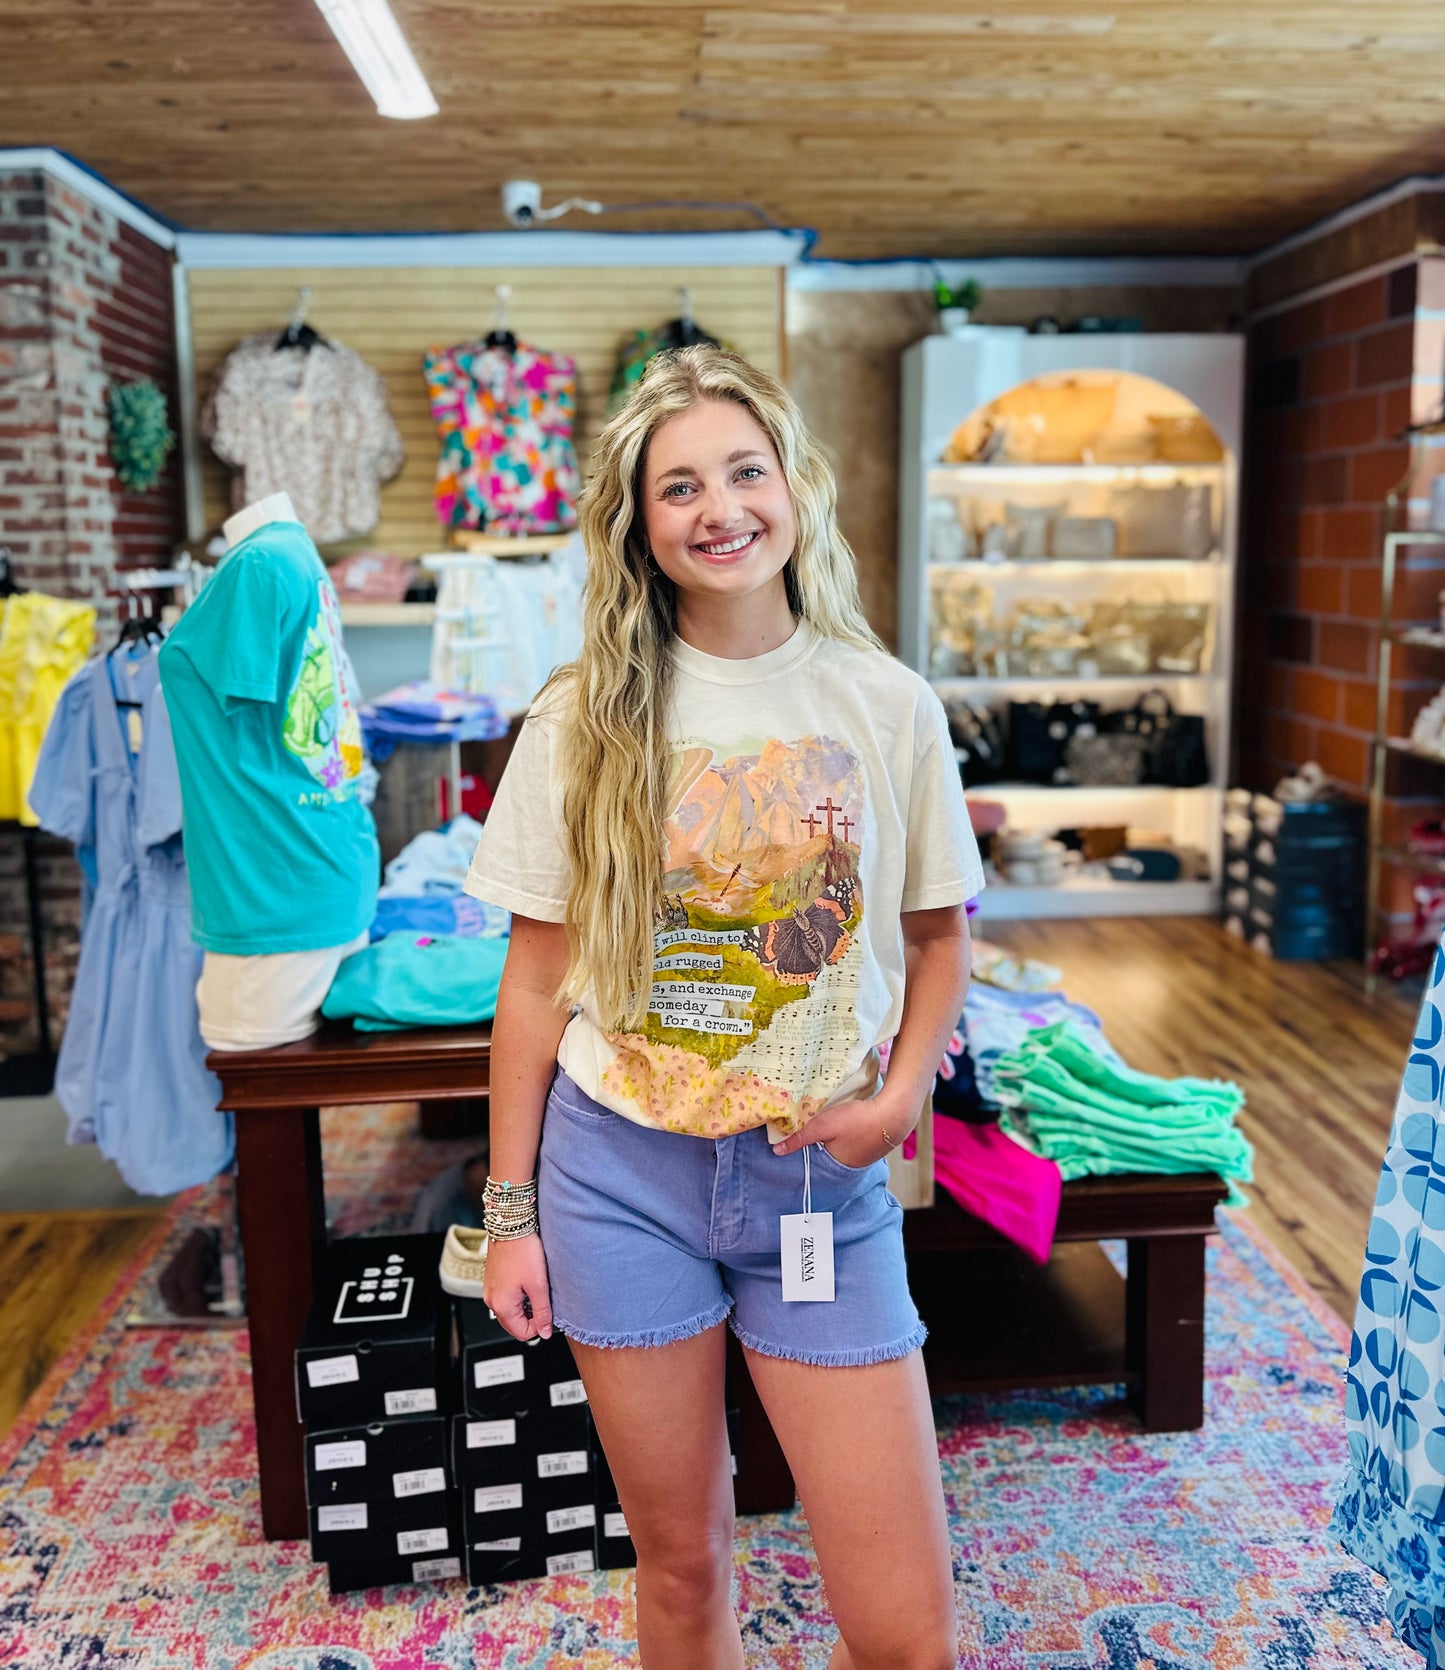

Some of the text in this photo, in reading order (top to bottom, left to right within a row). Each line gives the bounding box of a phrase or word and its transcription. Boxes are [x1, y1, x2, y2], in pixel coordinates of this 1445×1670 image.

[661, 931, 687, 945] will
[690, 932, 724, 946] cling
[727, 934, 741, 943] to
[675, 958, 722, 969] rugged
[669, 983, 695, 994] and
[698, 985, 753, 1000] exchange
[648, 999, 708, 1015] someday
[664, 1014, 689, 1026] for
[692, 1018, 701, 1028] a
[803, 1237, 814, 1282] ZENANA
[356, 1267, 382, 1303] SHU
[378, 1253, 405, 1302] SHOP
